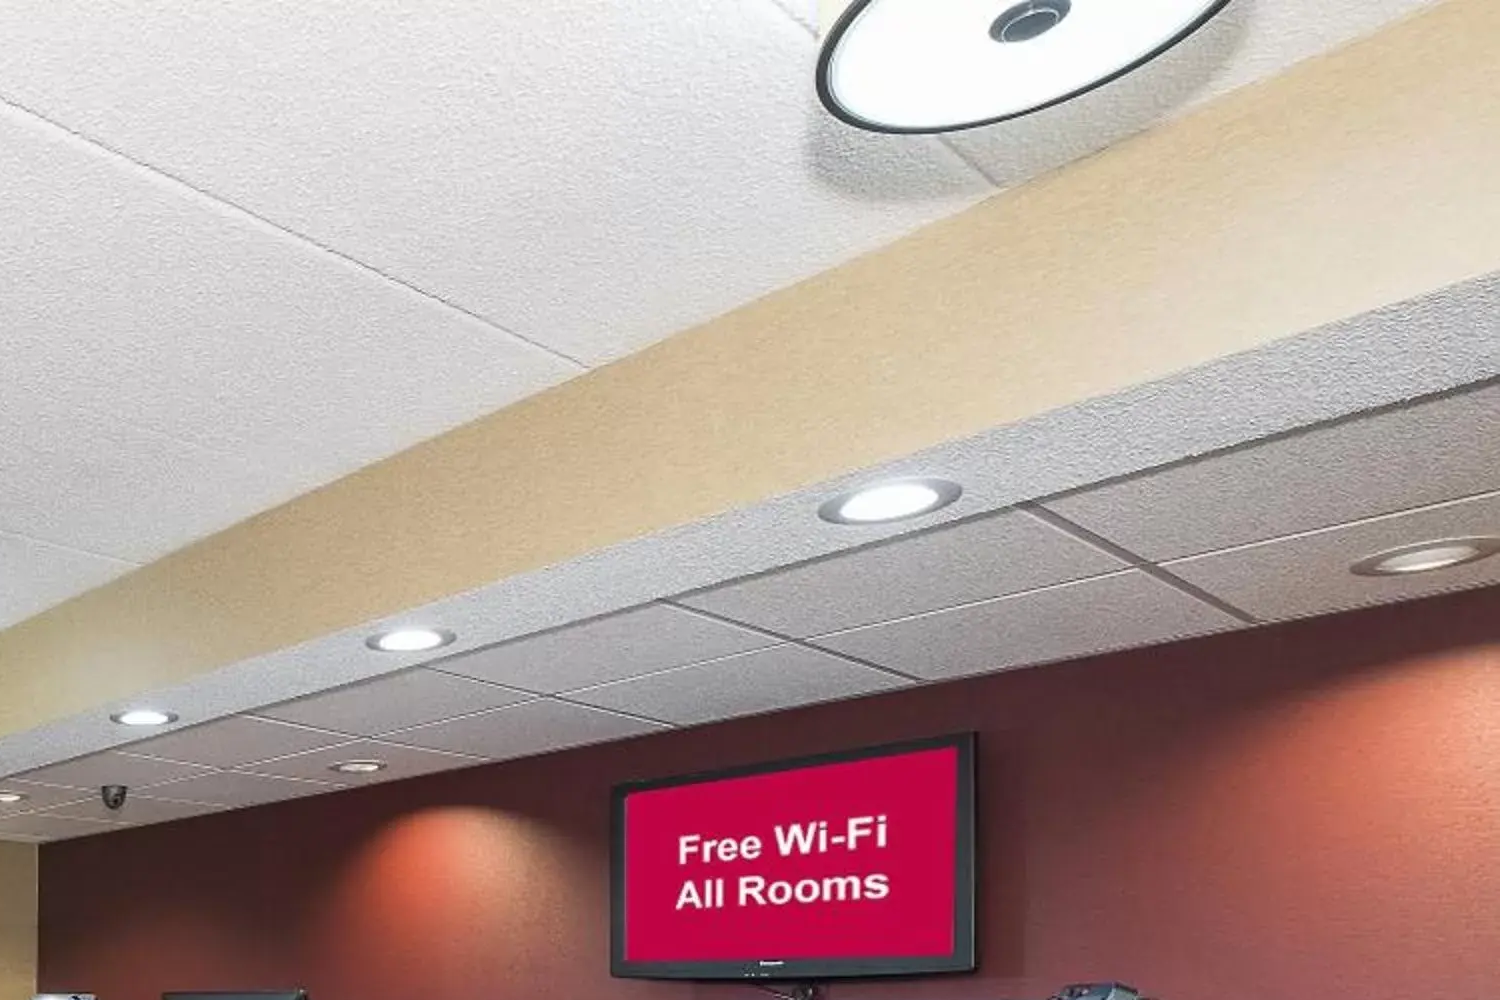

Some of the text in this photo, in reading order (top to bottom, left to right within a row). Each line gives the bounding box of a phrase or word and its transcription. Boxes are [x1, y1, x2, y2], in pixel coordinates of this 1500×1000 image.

[678, 814, 888, 865] Free Wi-Fi
[675, 872, 890, 911] All Rooms
